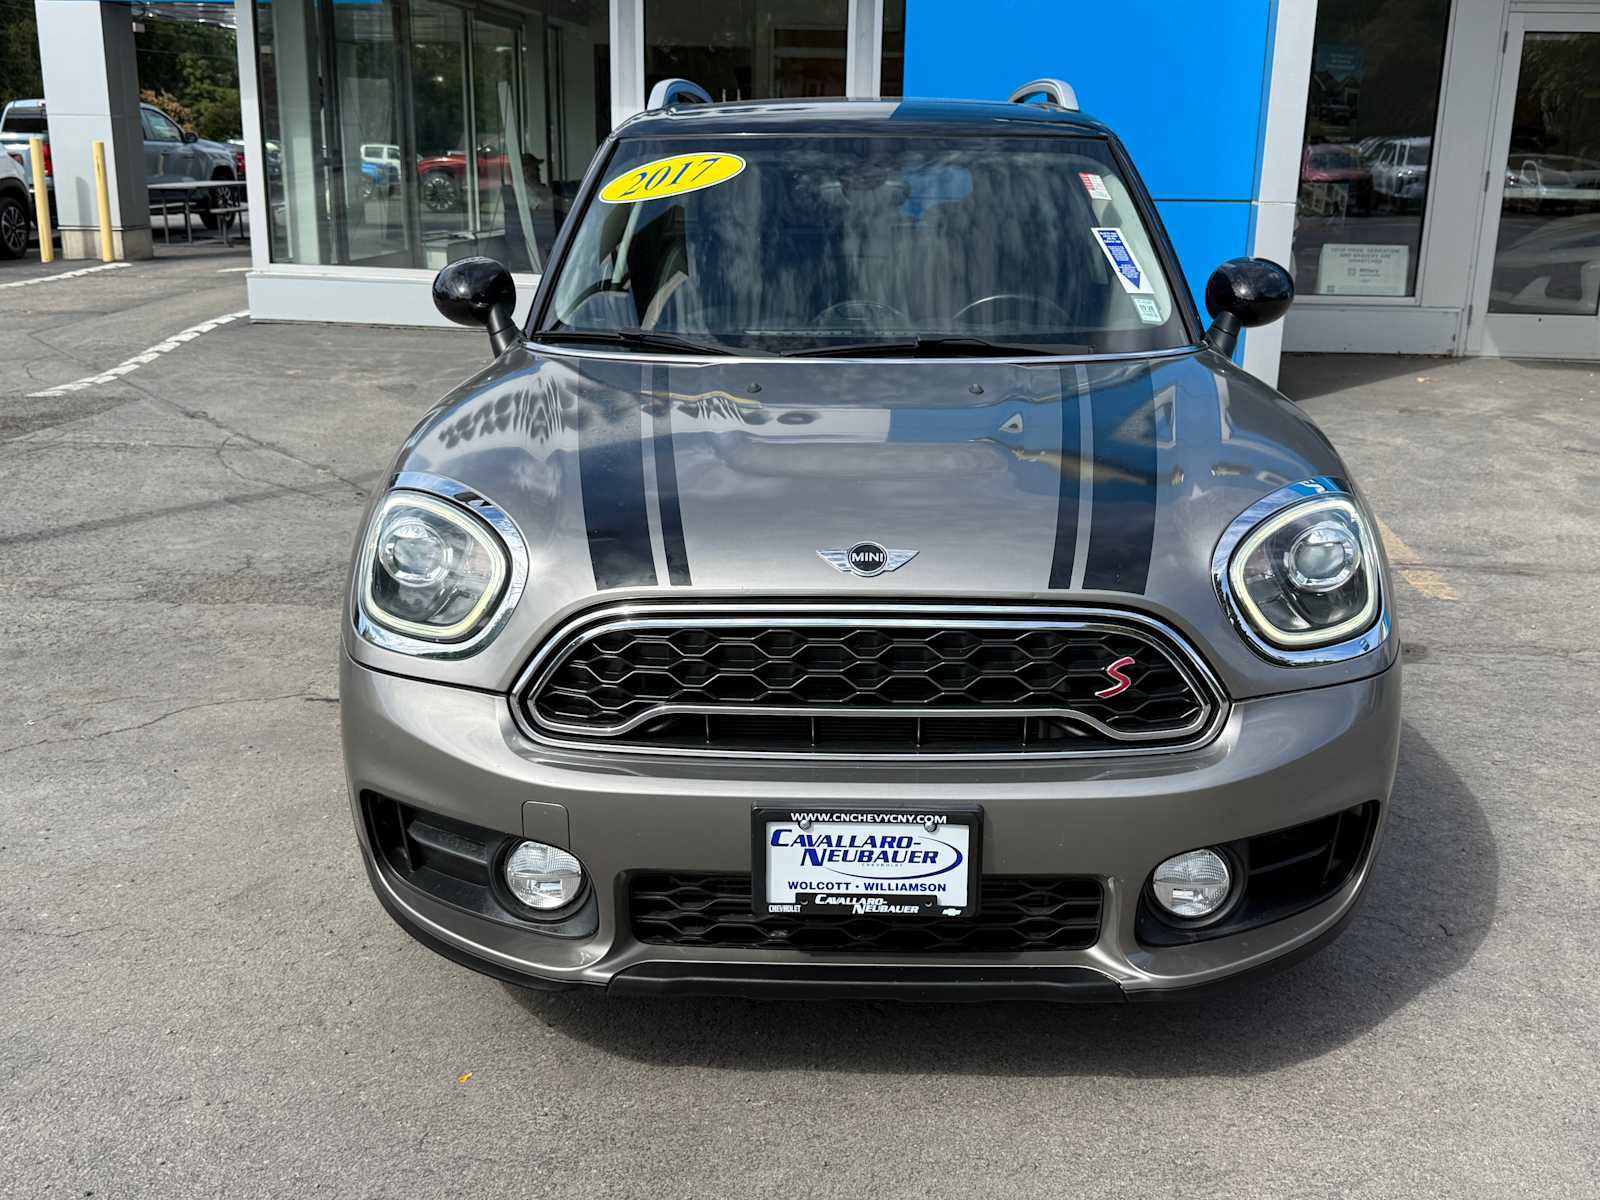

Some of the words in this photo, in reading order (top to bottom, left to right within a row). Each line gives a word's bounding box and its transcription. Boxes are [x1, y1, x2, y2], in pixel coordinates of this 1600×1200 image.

[618, 157, 721, 199] 2017
[851, 552, 884, 563] MINI
[1094, 656, 1136, 699] S
[790, 812, 948, 825] WWW.CNCHEVYCNY.COM
[770, 828, 922, 849] CAVALLARO-
[800, 848, 940, 867] NEUBAUER
[787, 881, 852, 891] WOLCOTT
[863, 882, 947, 893] WILLIAMSON
[814, 893, 888, 905] CAVALLARO-
[852, 903, 920, 915] NEUBAUER
